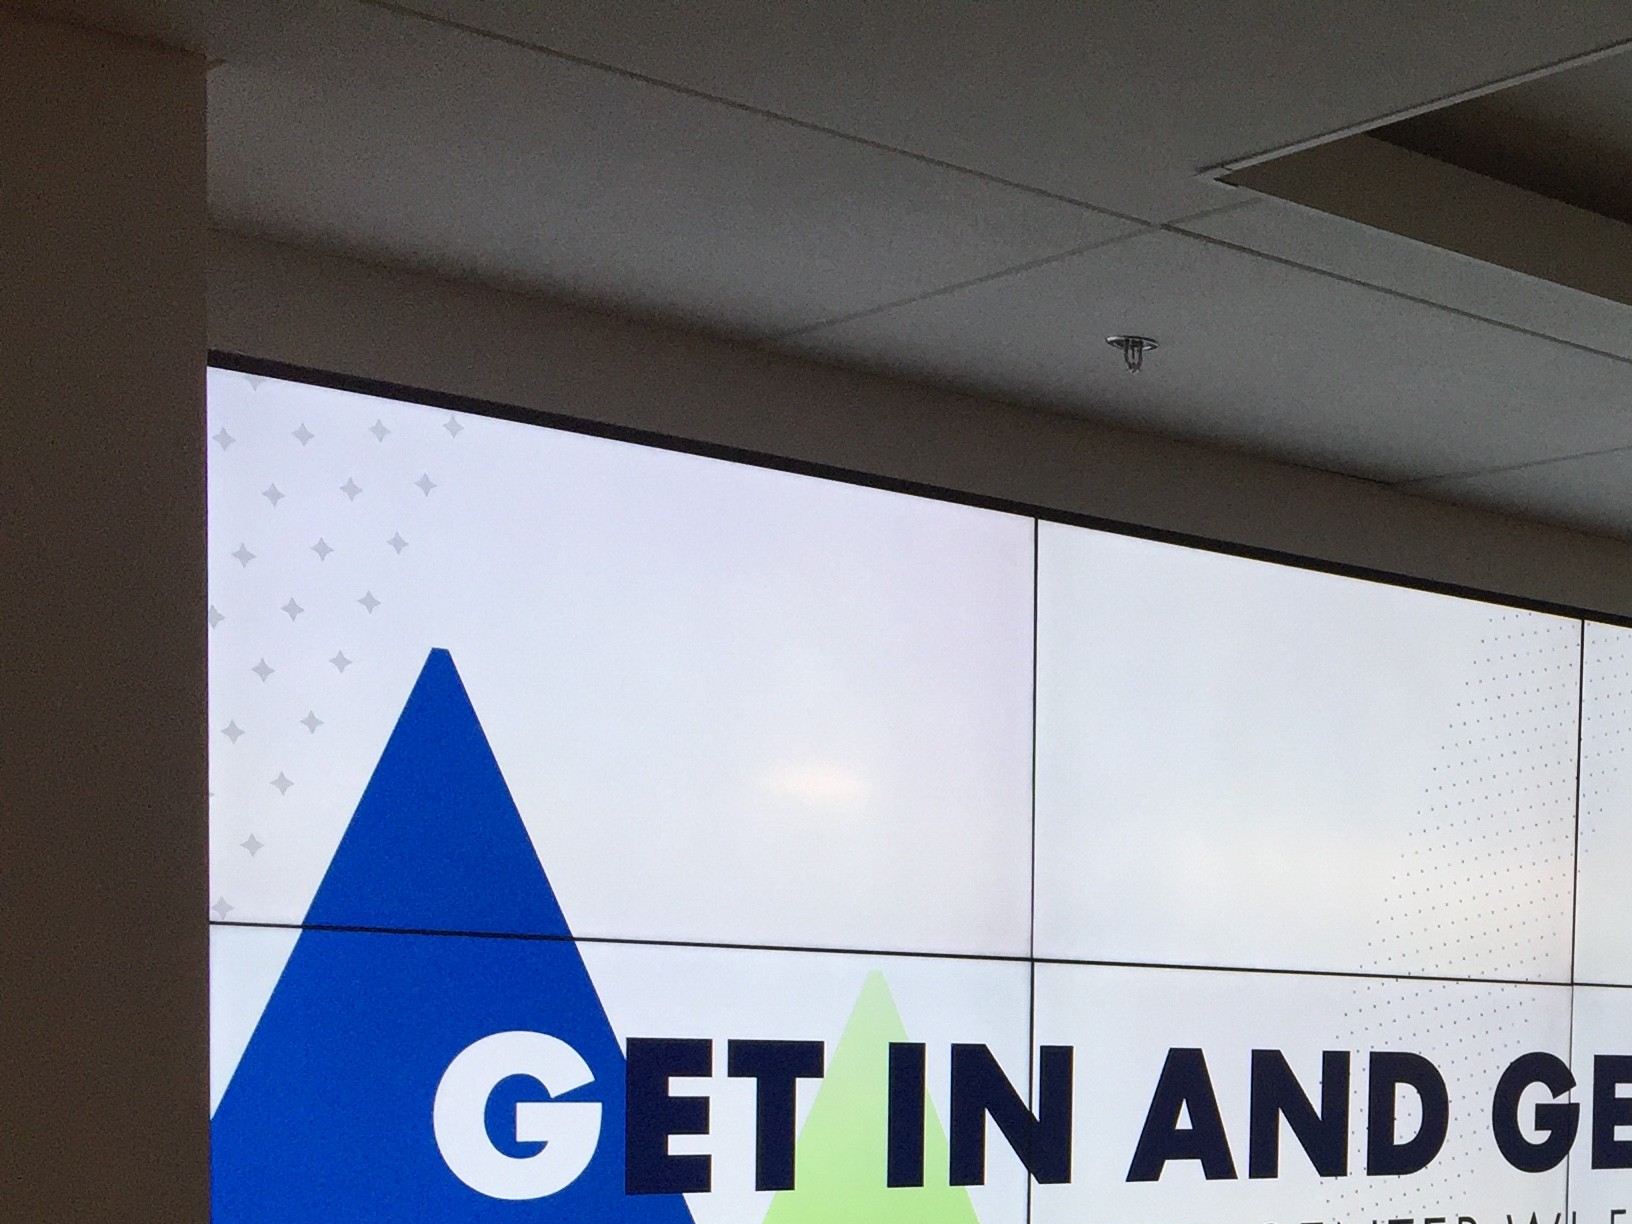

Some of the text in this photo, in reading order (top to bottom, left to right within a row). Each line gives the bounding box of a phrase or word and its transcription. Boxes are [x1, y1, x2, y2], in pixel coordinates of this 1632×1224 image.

[432, 1030, 825, 1200] GET
[887, 1042, 1074, 1187] IN
[1125, 1047, 1449, 1182] AND
